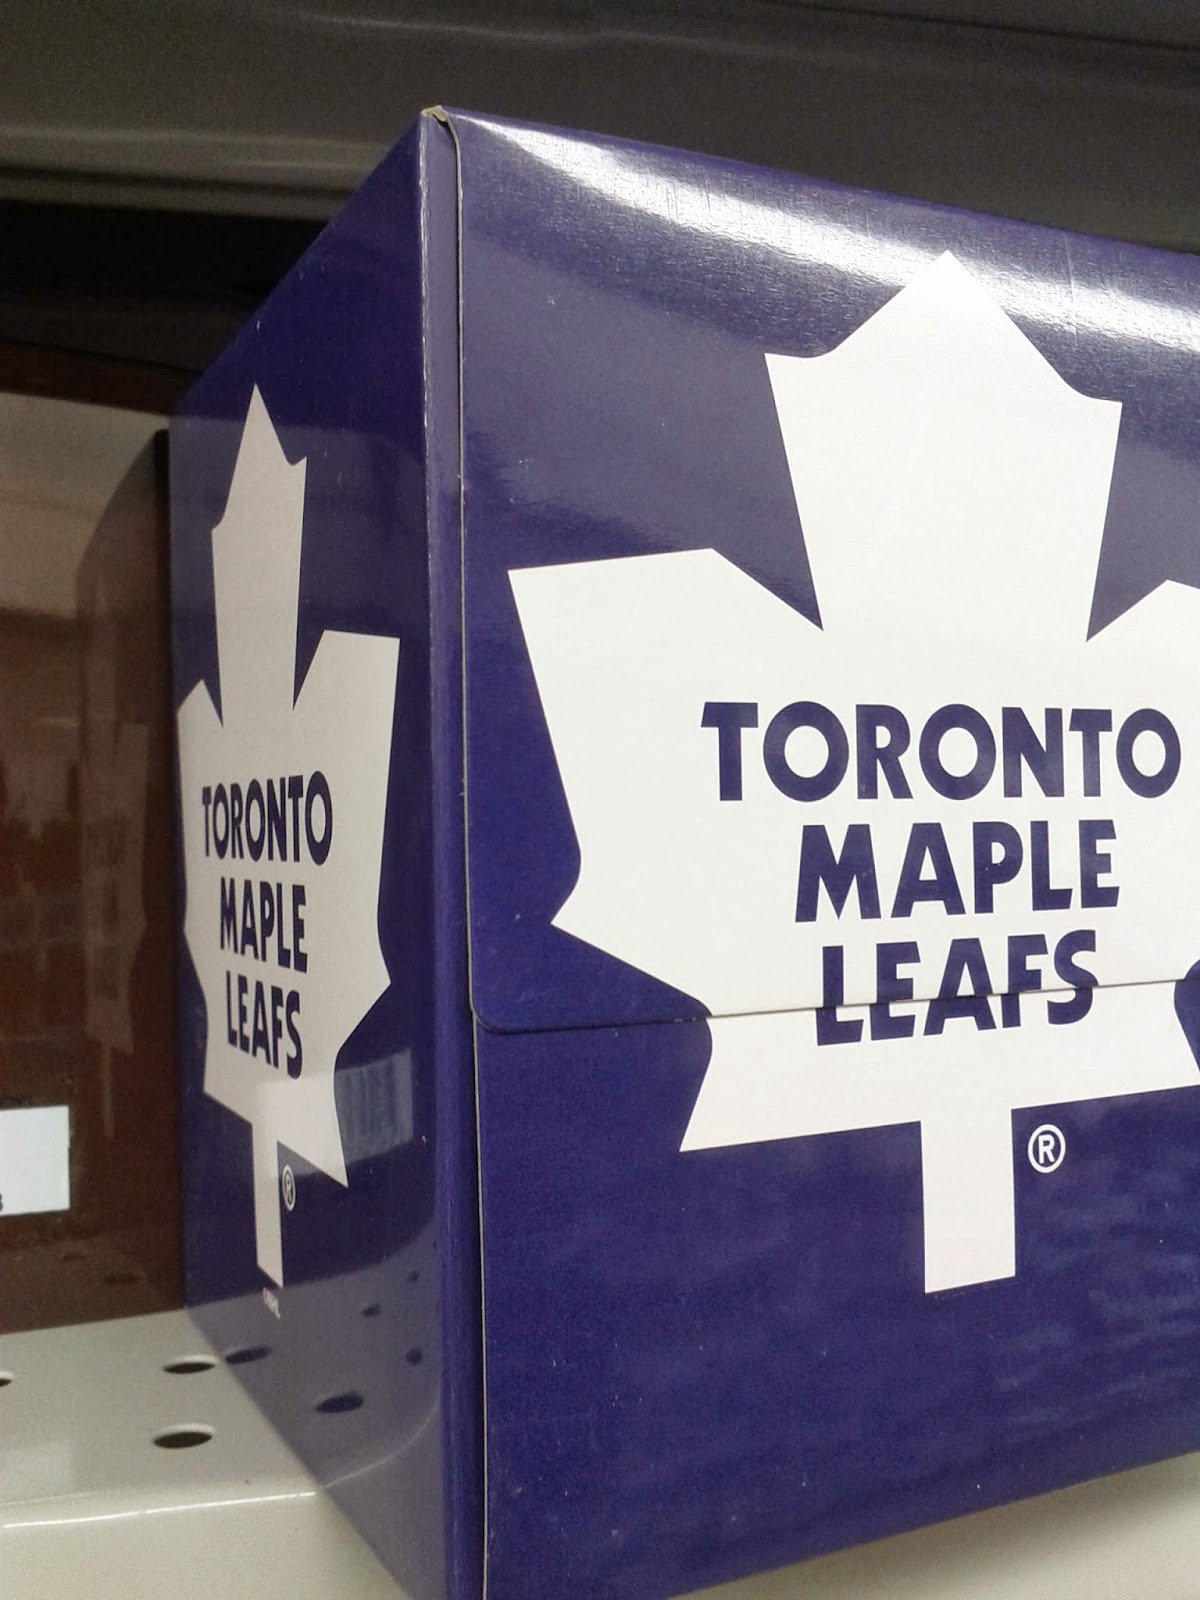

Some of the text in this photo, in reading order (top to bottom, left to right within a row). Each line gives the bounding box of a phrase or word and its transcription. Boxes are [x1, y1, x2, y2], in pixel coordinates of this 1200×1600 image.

[701, 701, 1181, 802] TORONTO
[202, 770, 333, 866] TORONTO
[795, 819, 1120, 923] MAPLE
[220, 877, 307, 973] MAPLE
[226, 970, 303, 1079] LEAFS
[815, 929, 1100, 1046] LEAFS
